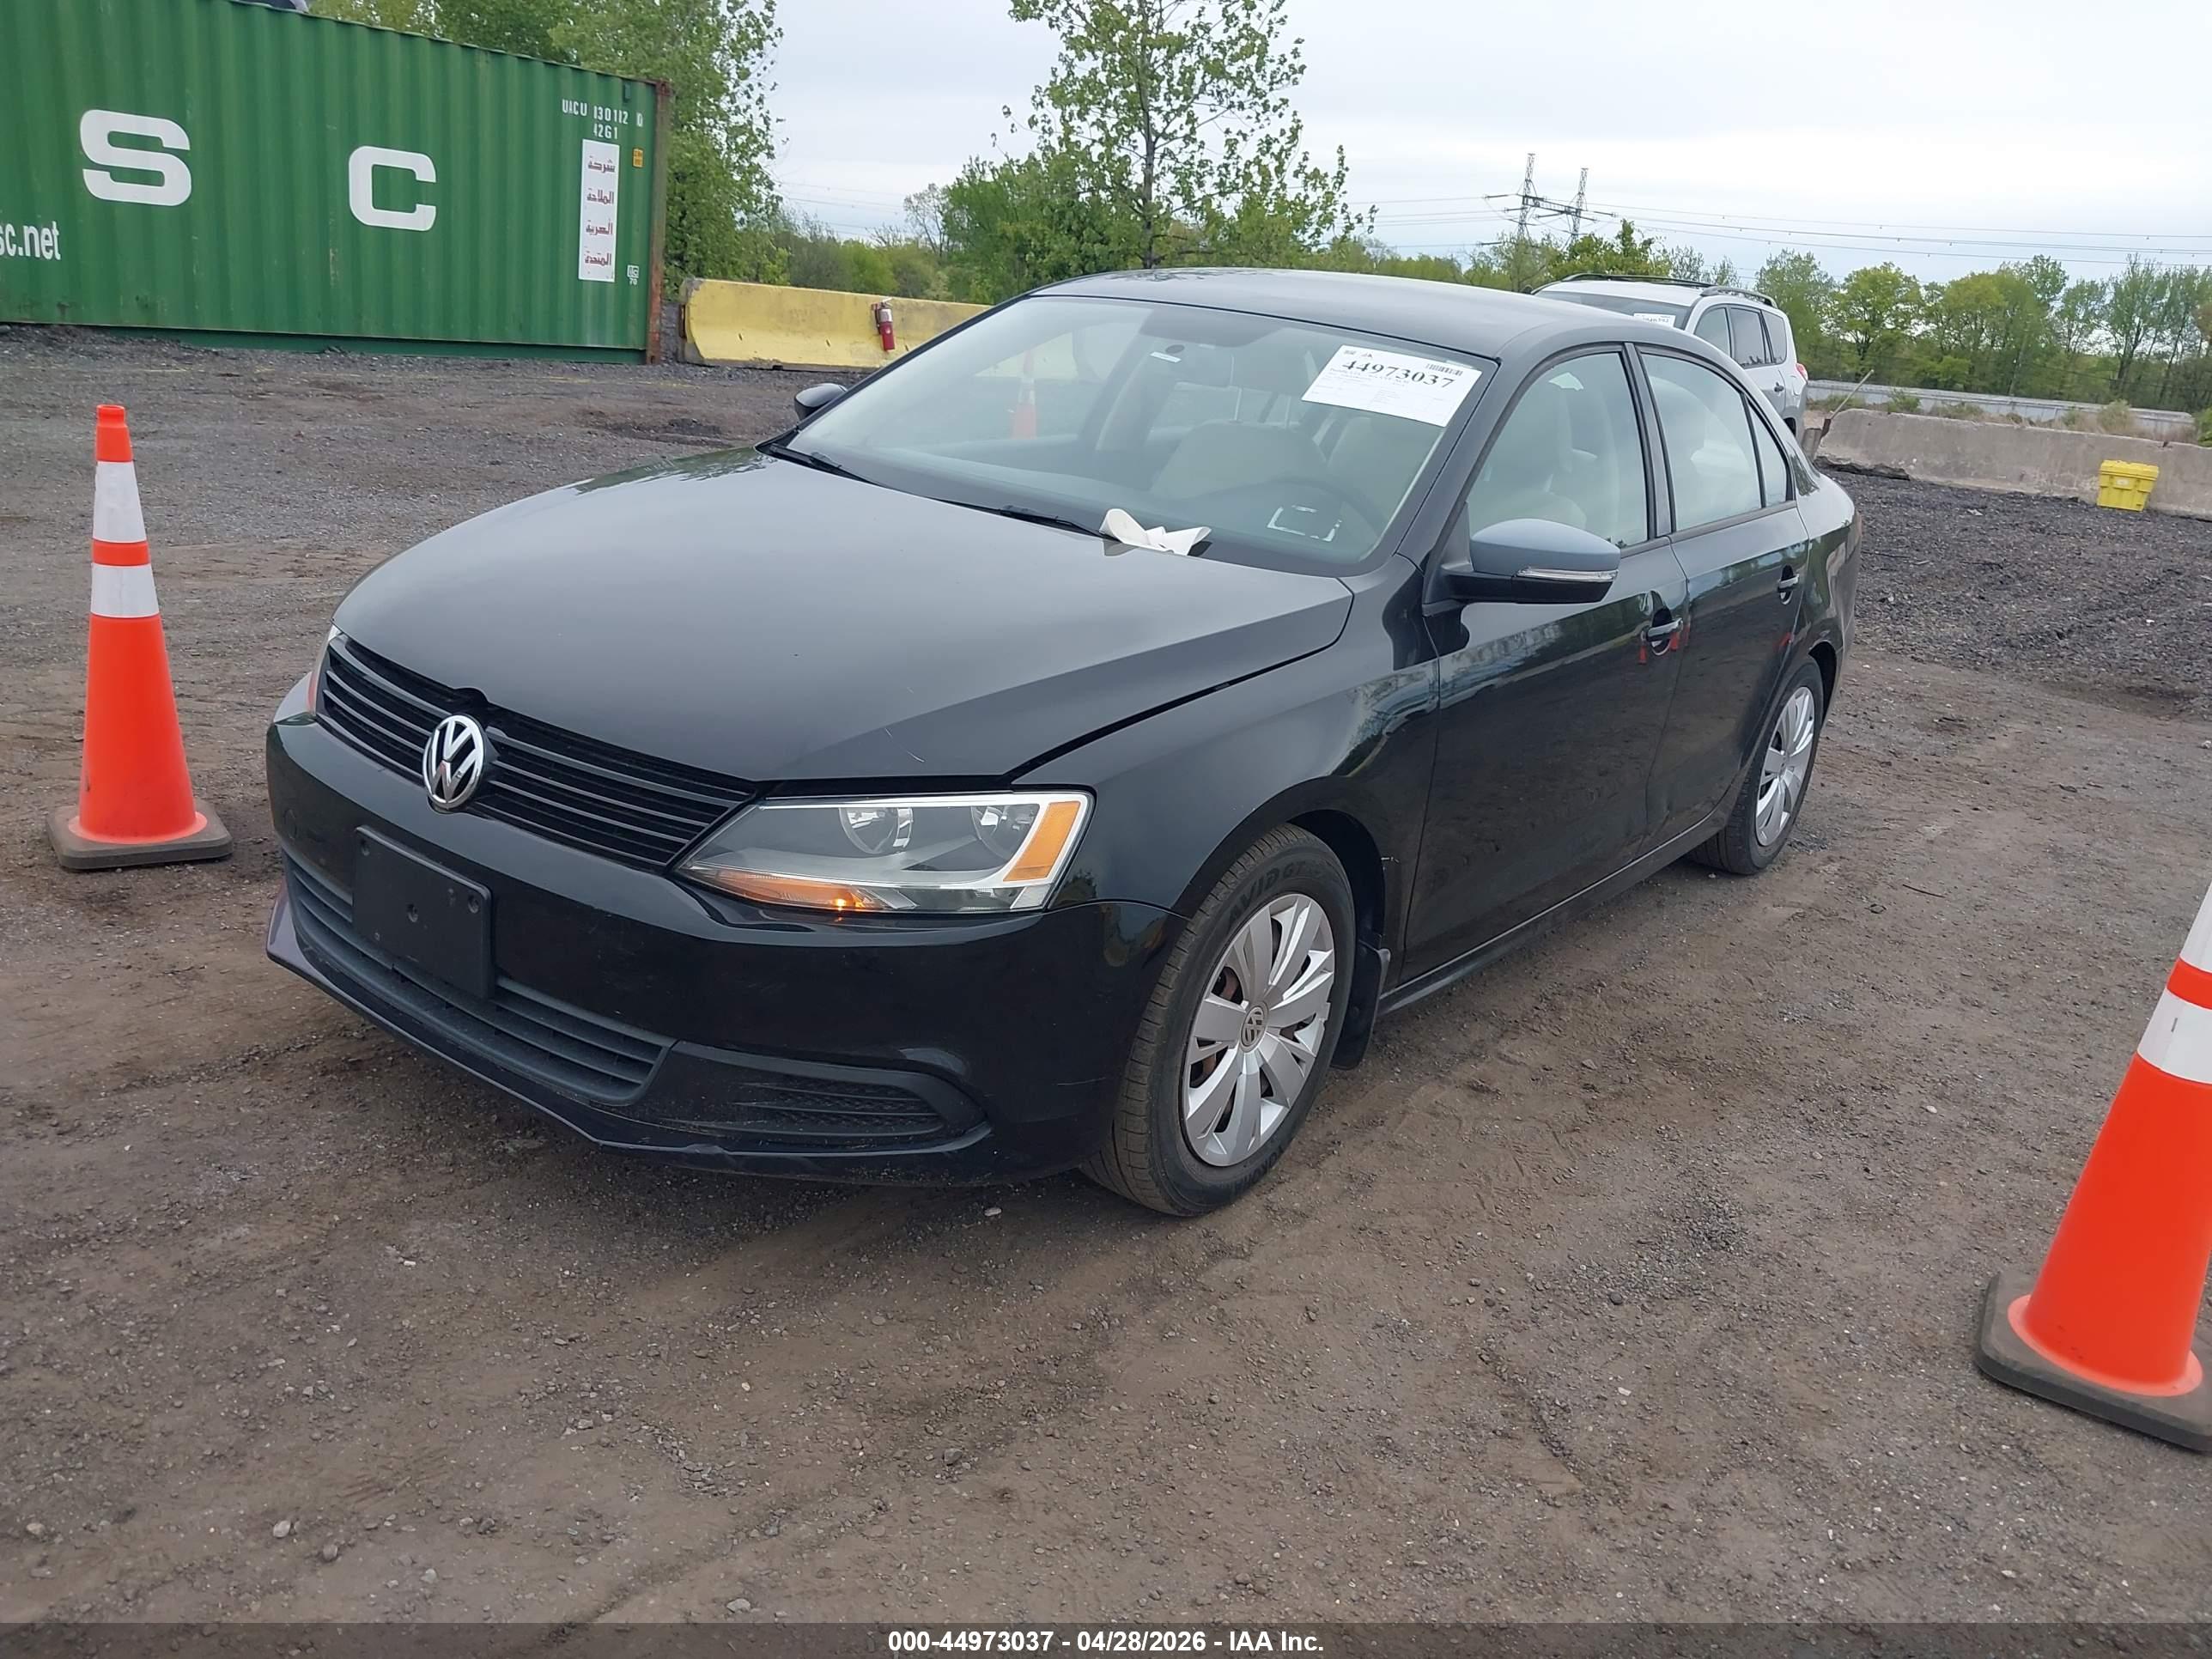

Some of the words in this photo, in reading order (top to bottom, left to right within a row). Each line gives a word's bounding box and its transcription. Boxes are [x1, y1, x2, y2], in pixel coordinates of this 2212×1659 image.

[562, 99, 587, 117] UACU
[593, 106, 629, 125] 130112
[79, 109, 192, 207] S
[348, 145, 437, 232] C
[586, 155, 616, 174] شركة
[586, 187, 615, 206] الملاحة
[584, 250, 612, 267] المتحدة
[1340, 359, 1455, 388] 44973037
